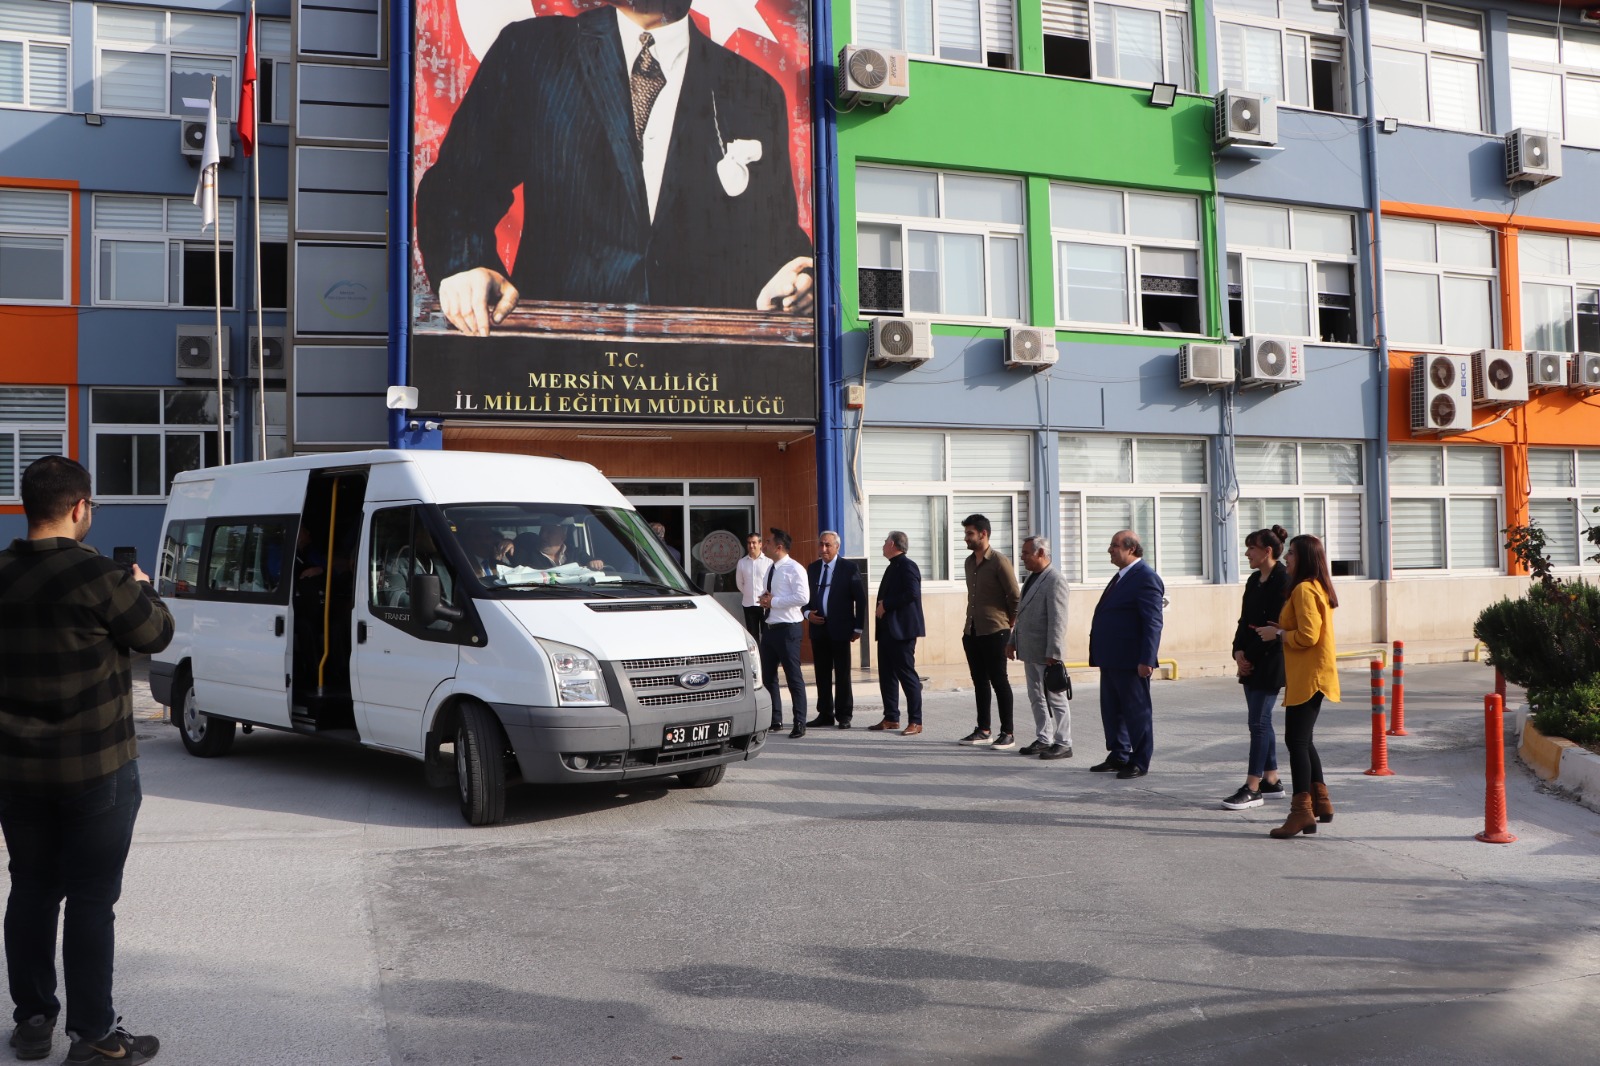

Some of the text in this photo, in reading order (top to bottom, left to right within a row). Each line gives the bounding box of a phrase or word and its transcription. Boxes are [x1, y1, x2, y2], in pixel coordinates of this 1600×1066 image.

[604, 352, 645, 368] T.C.
[1290, 346, 1298, 375] VESTEL
[527, 370, 719, 392] MERSİN VALİLİĞİ
[454, 390, 785, 415] İL MİLLİ EĞİTİM MÜDÜRLÜĞÜ
[384, 612, 411, 621] TRANSIT
[672, 722, 729, 743] 33 CNT 50
